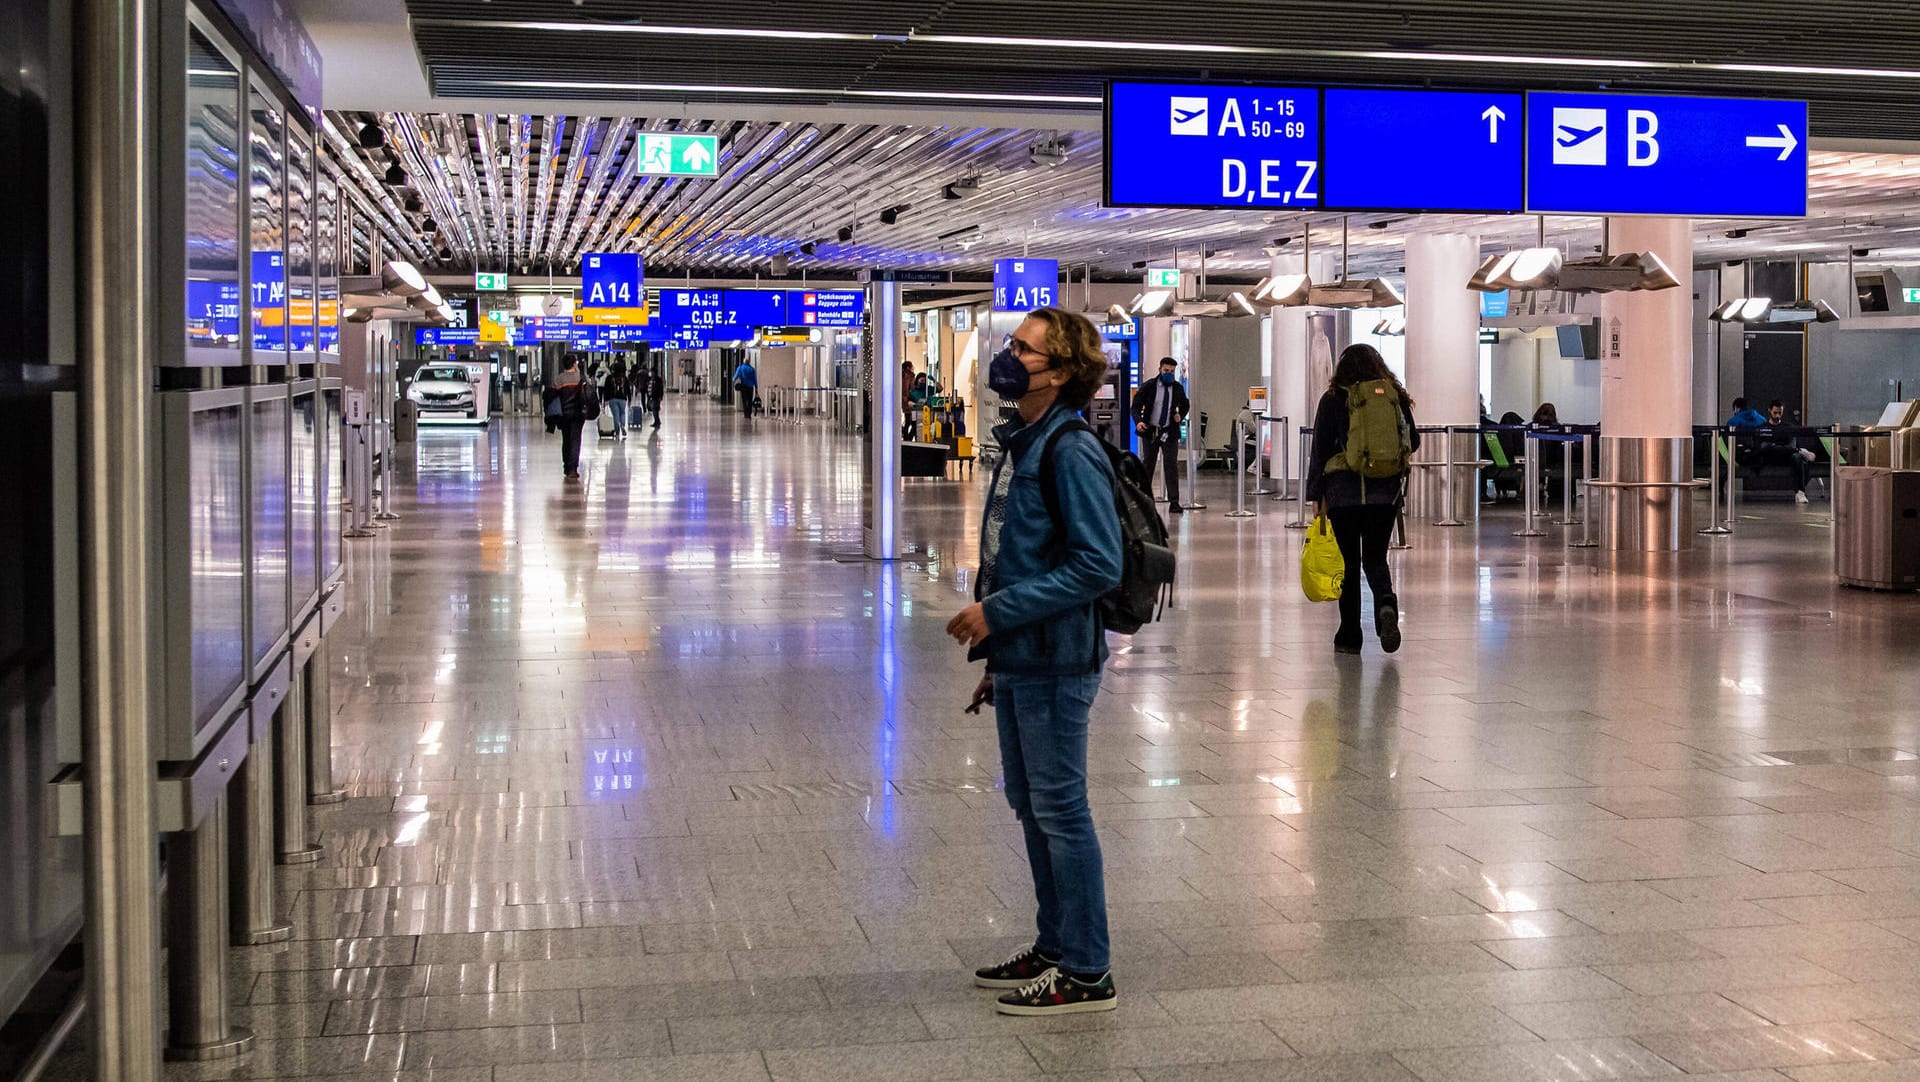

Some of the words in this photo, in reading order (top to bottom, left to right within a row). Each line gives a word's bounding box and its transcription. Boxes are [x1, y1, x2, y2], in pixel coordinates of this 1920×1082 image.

[1217, 97, 1247, 137] A
[1627, 109, 1660, 167] B
[691, 293, 701, 306] A
